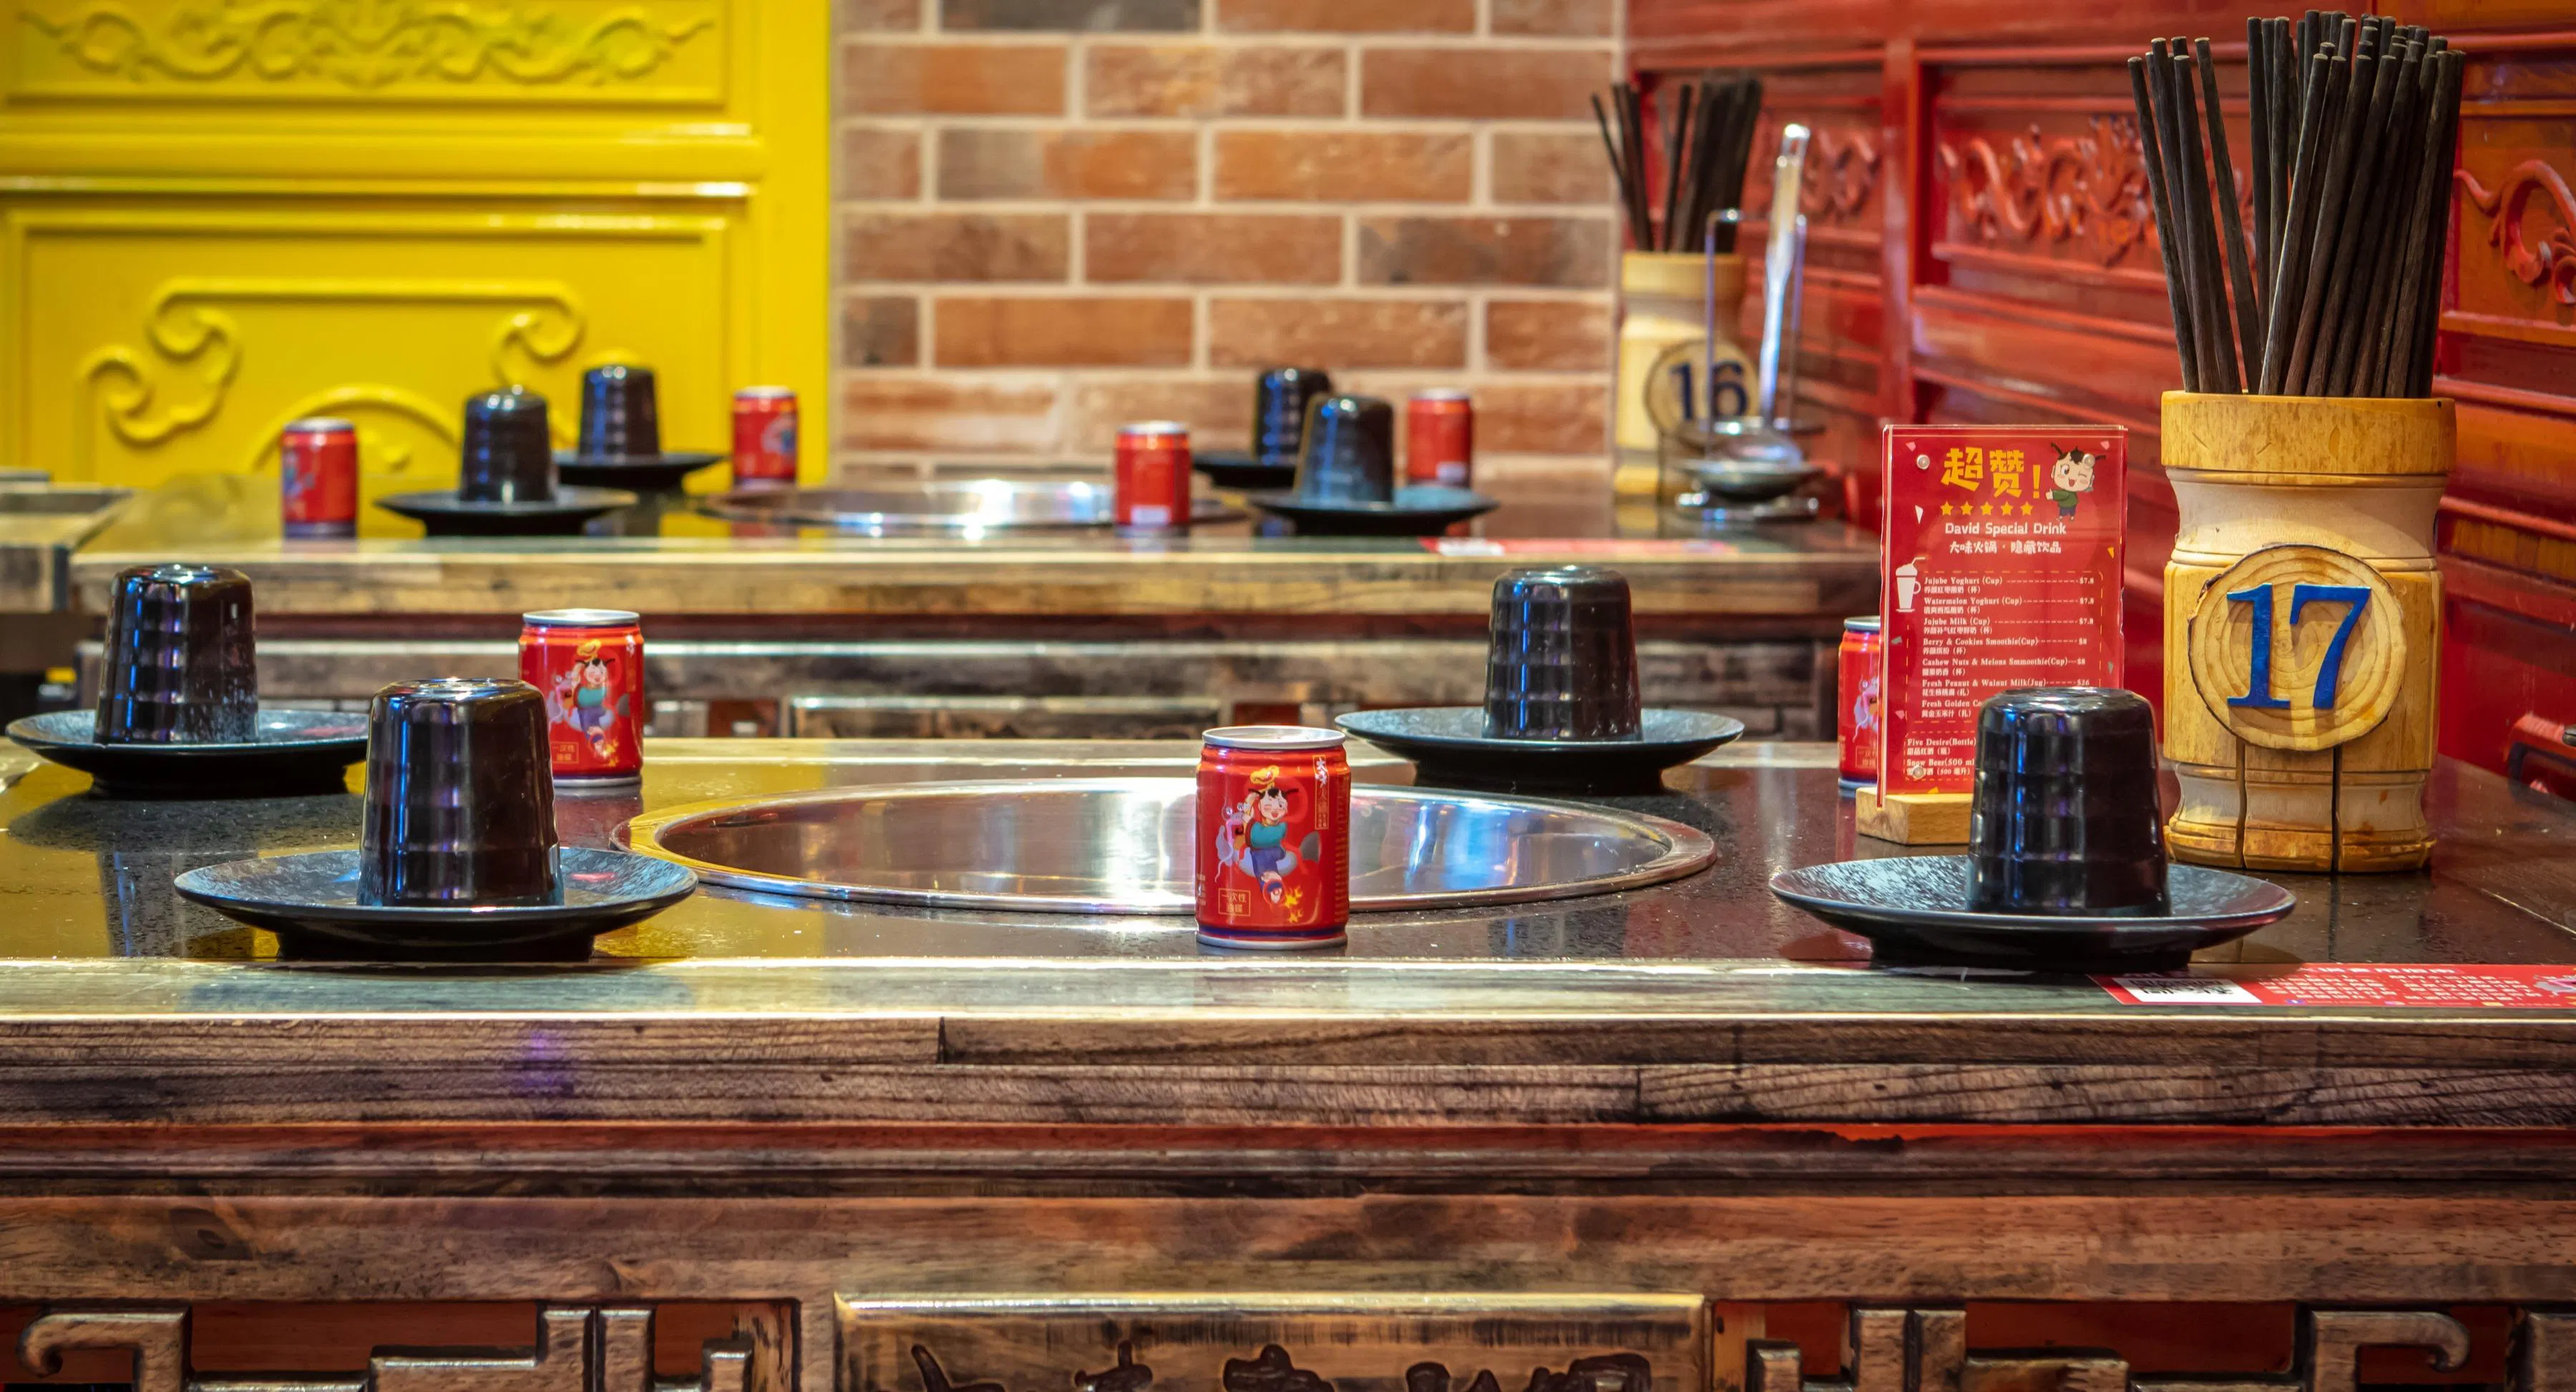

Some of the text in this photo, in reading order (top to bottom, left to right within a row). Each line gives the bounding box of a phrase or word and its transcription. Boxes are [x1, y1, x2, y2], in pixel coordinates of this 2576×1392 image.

[1669, 360, 1749, 422] 16
[1945, 522, 2067, 537] David Special Drink
[1982, 575, 2003, 585] (Cup)
[1970, 597, 1999, 606] Yoghurt
[2001, 596, 2022, 606] (Cup)
[1969, 616, 1990, 626] (Cup)
[1923, 638, 1943, 646] Berry
[2226, 582, 2371, 710] 17
[2077, 678, 2089, 686] $26
